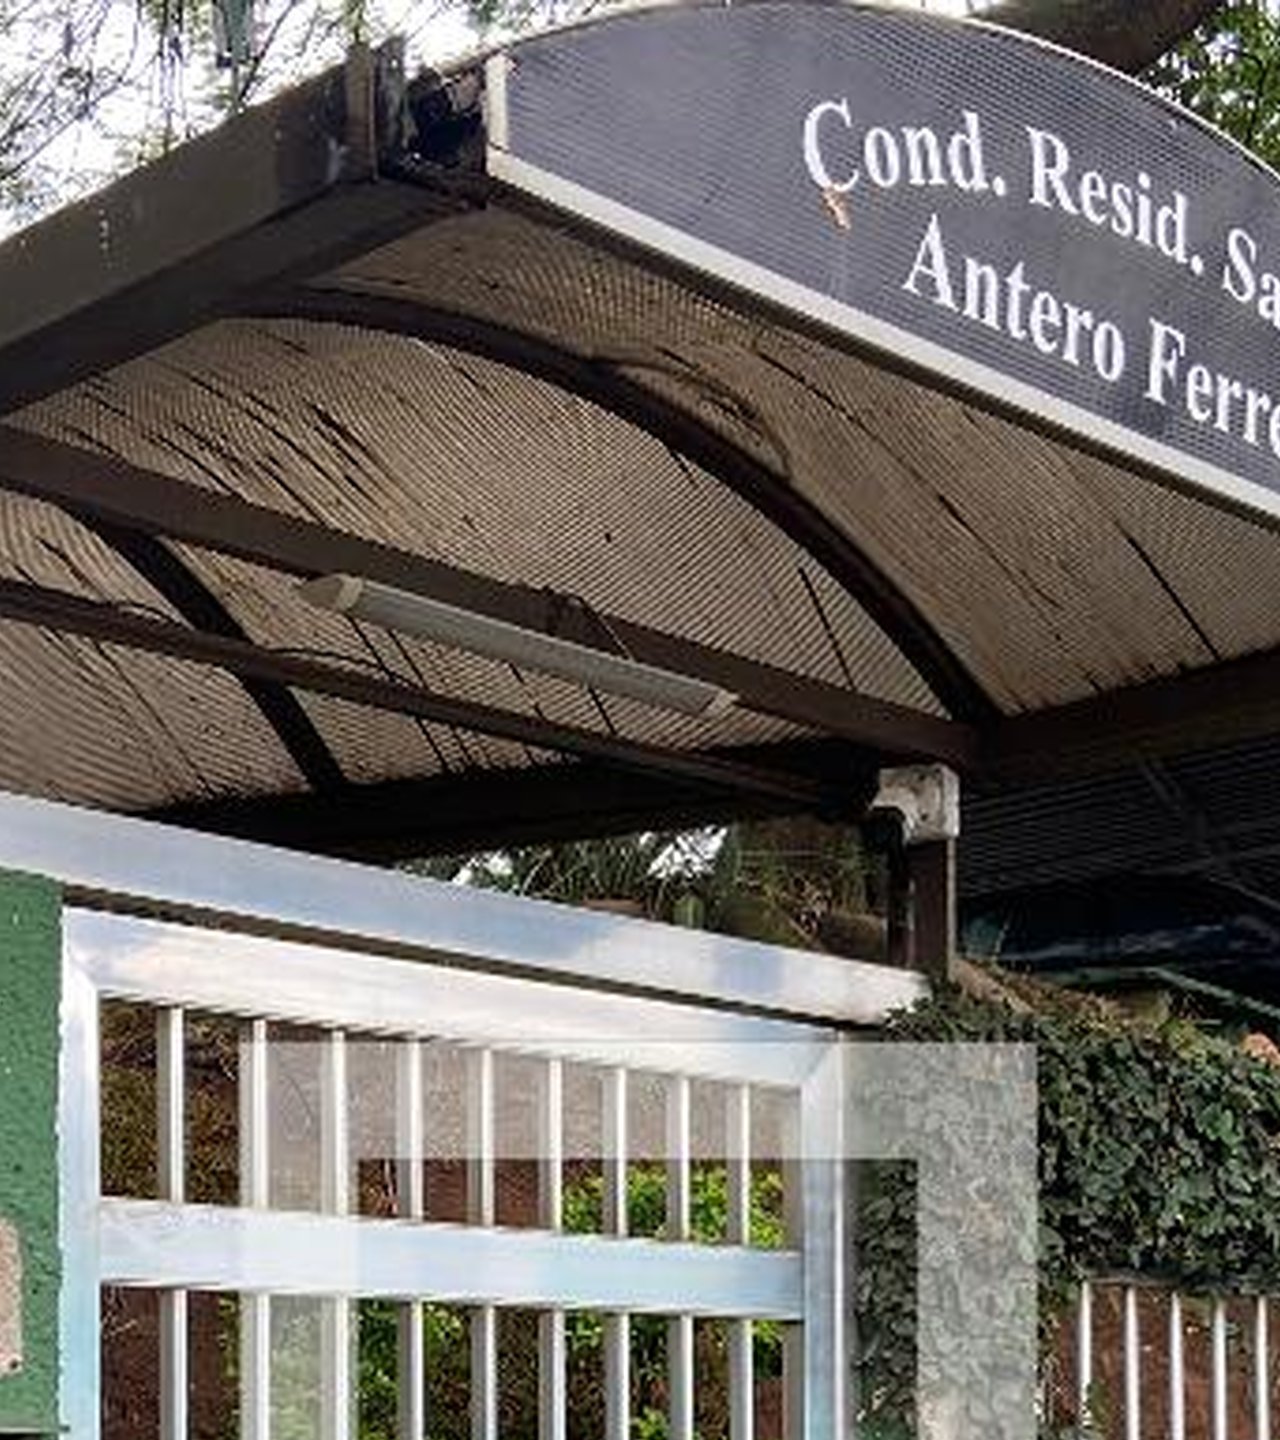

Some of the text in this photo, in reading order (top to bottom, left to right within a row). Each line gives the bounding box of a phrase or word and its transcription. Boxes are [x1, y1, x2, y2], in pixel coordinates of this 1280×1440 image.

[803, 97, 1007, 197] Cond.
[1026, 125, 1205, 276] Resid.
[901, 212, 1125, 383] Antero
